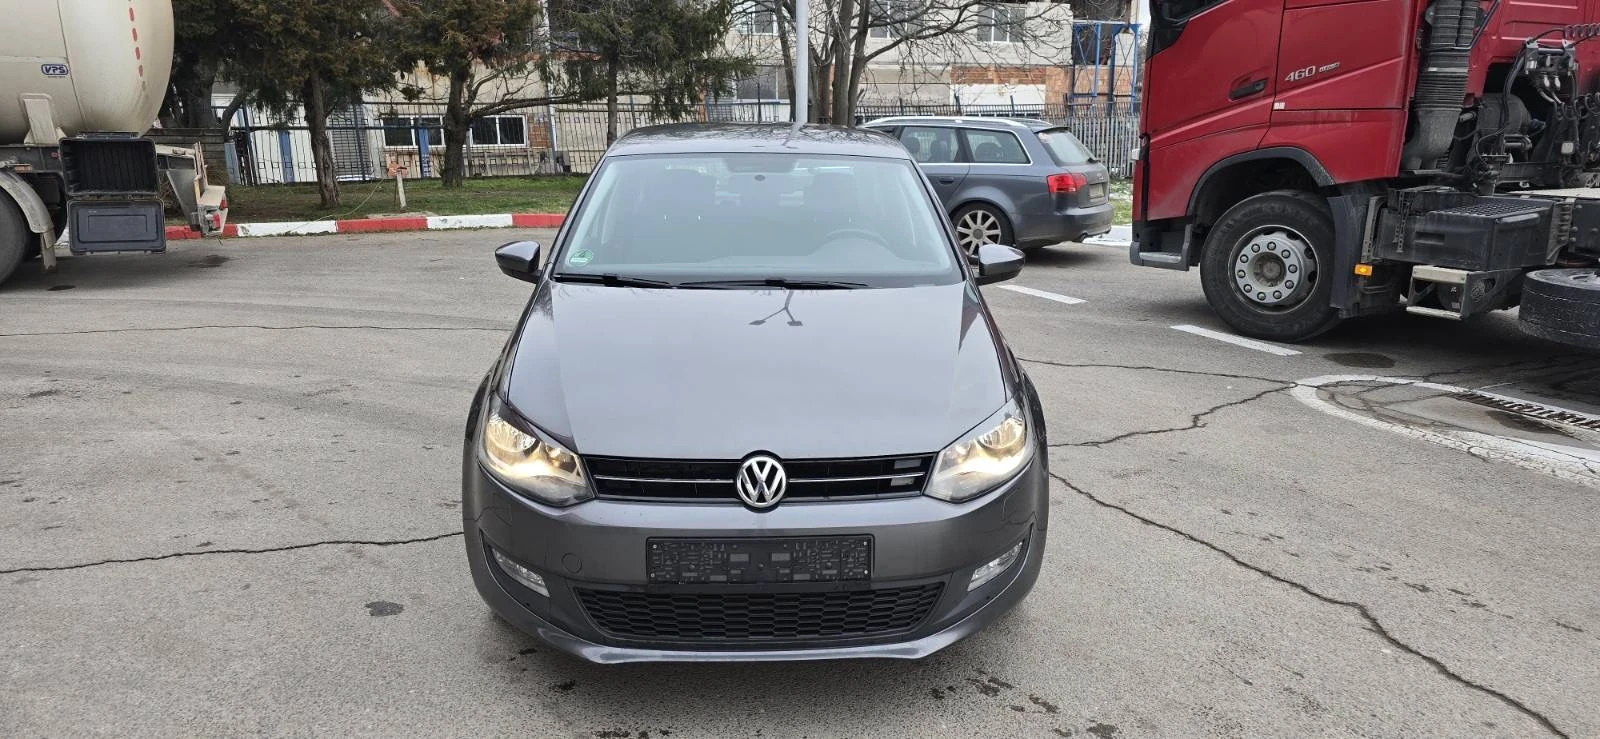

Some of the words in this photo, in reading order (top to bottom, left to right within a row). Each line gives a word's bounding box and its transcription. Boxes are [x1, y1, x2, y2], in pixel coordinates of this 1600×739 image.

[44, 66, 66, 74] VPS
[1284, 65, 1316, 81] 460
[737, 456, 786, 508] VW
